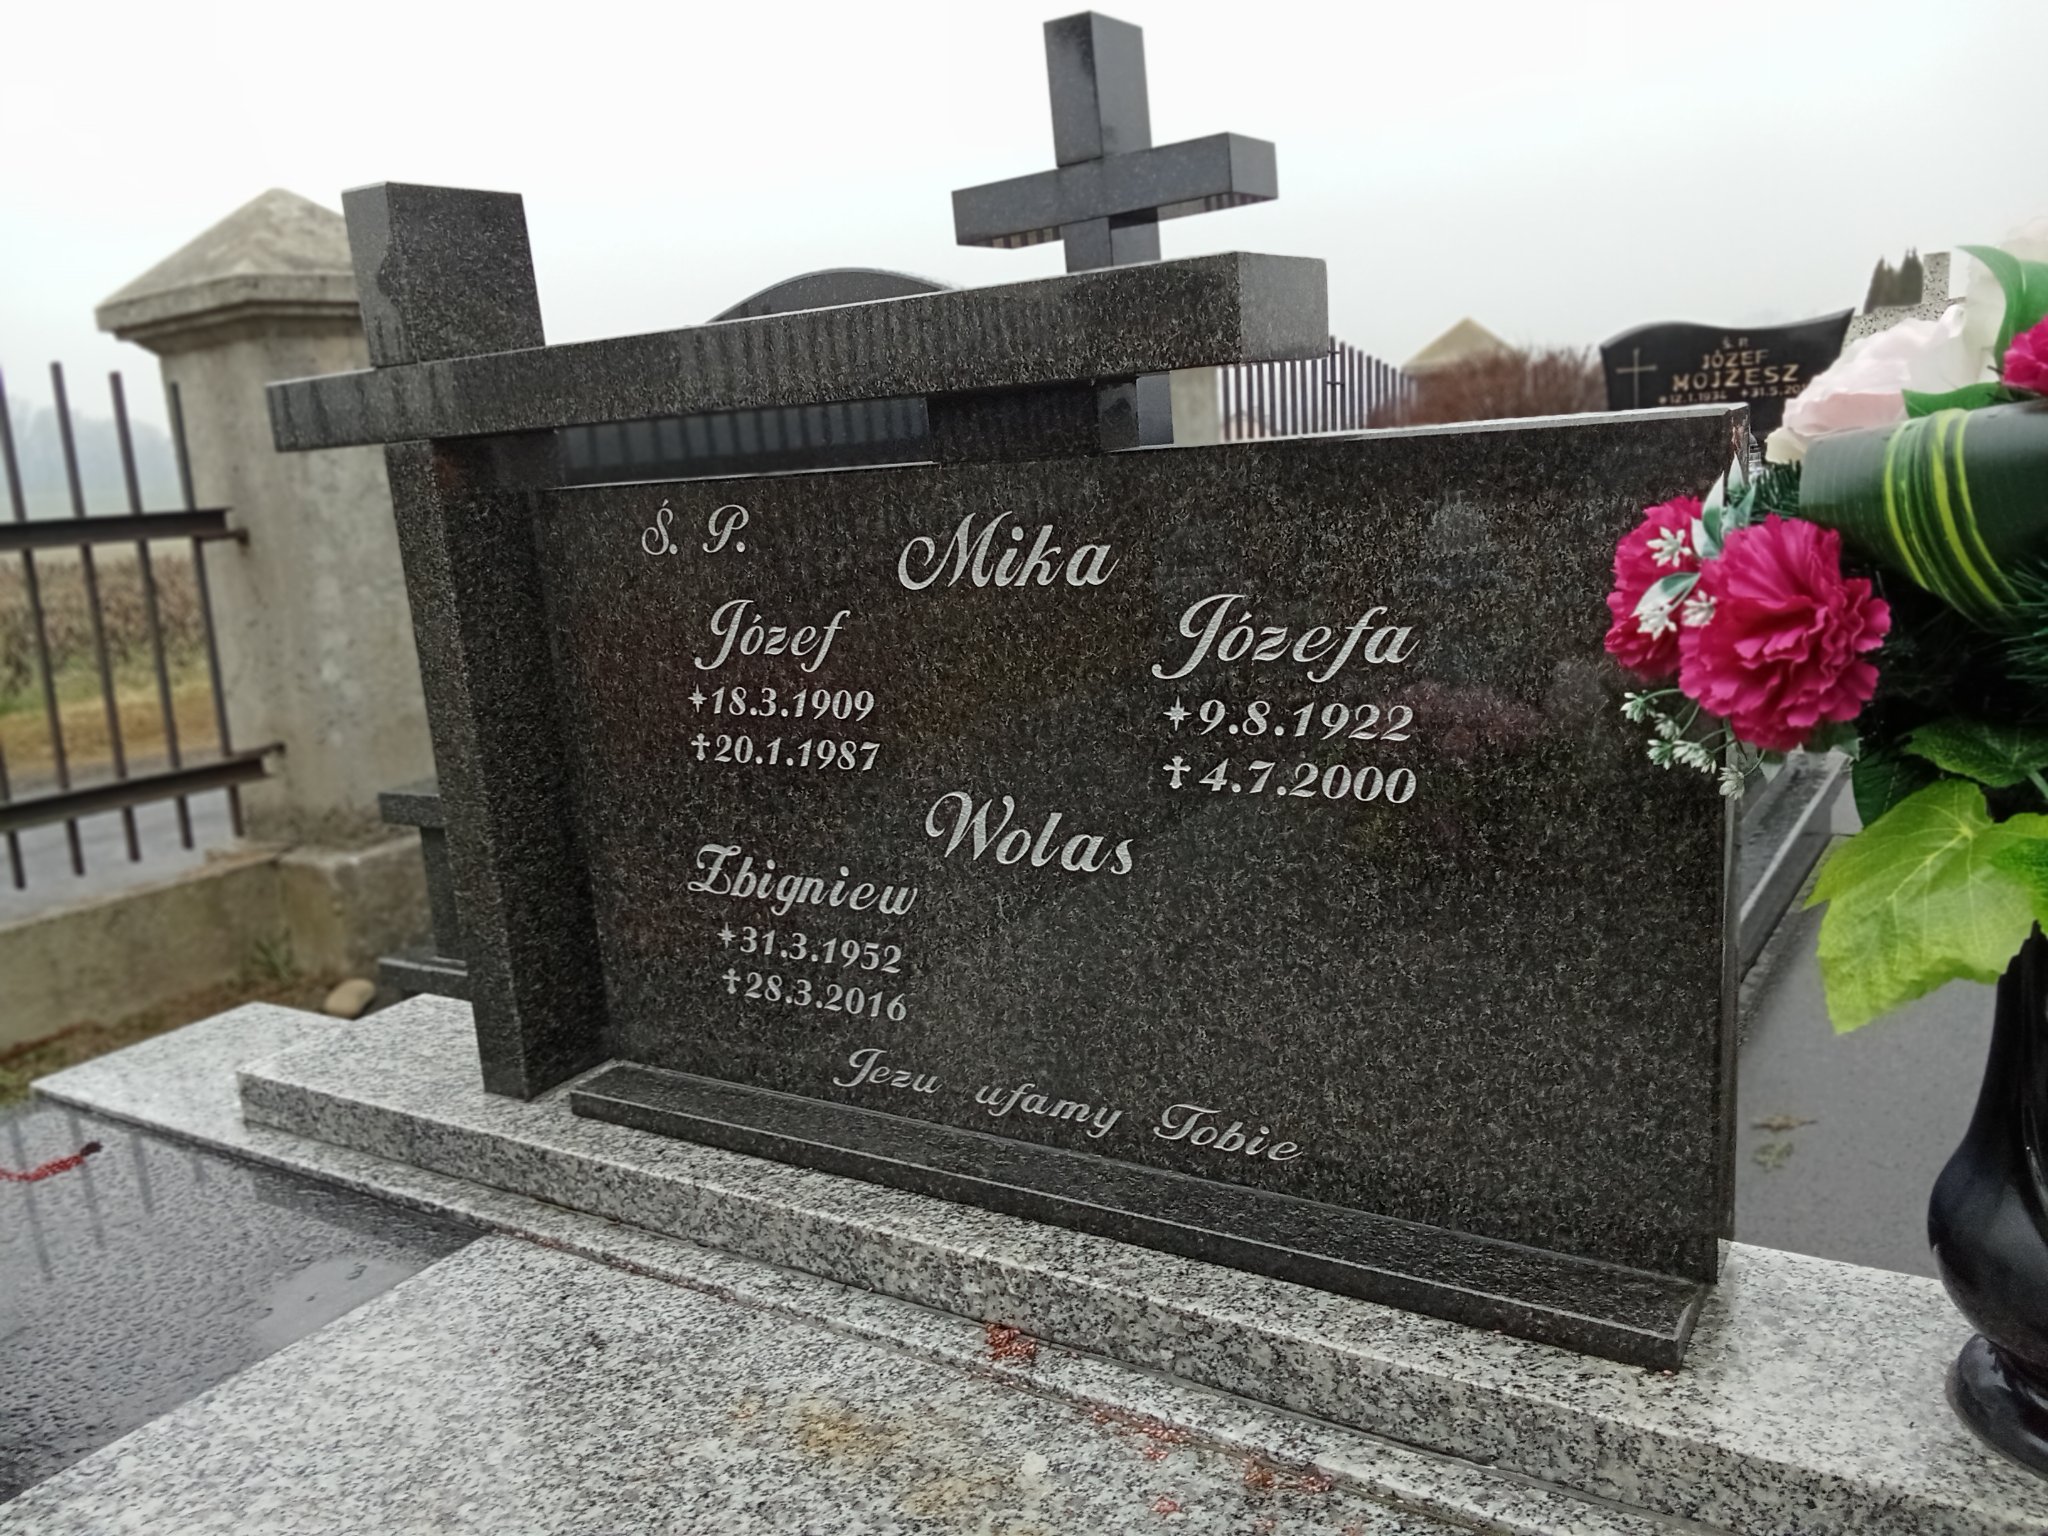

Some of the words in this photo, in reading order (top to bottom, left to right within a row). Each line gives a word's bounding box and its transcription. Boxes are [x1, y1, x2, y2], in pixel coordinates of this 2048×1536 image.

[1702, 349, 1768, 370] JÓZEF
[641, 500, 678, 555] Ś.
[702, 504, 750, 554] P.
[897, 510, 1120, 590] Mika
[694, 599, 850, 673] Józef
[1151, 593, 1421, 683] Józefa
[711, 685, 876, 722] 18.3.1909
[1199, 699, 1414, 742] 9.8.1922
[714, 733, 882, 771] 20.1.1987
[1198, 757, 1417, 804] 4.7.2000
[925, 790, 1135, 876] Wolas
[687, 843, 919, 917] Zbigniew
[738, 930, 903, 974] 31.3.1952
[744, 971, 908, 1022] 28.3.2016
[833, 1047, 942, 1095] Jezu
[976, 1081, 1123, 1138] ufamy
[1152, 1102, 1304, 1162] Tobie
